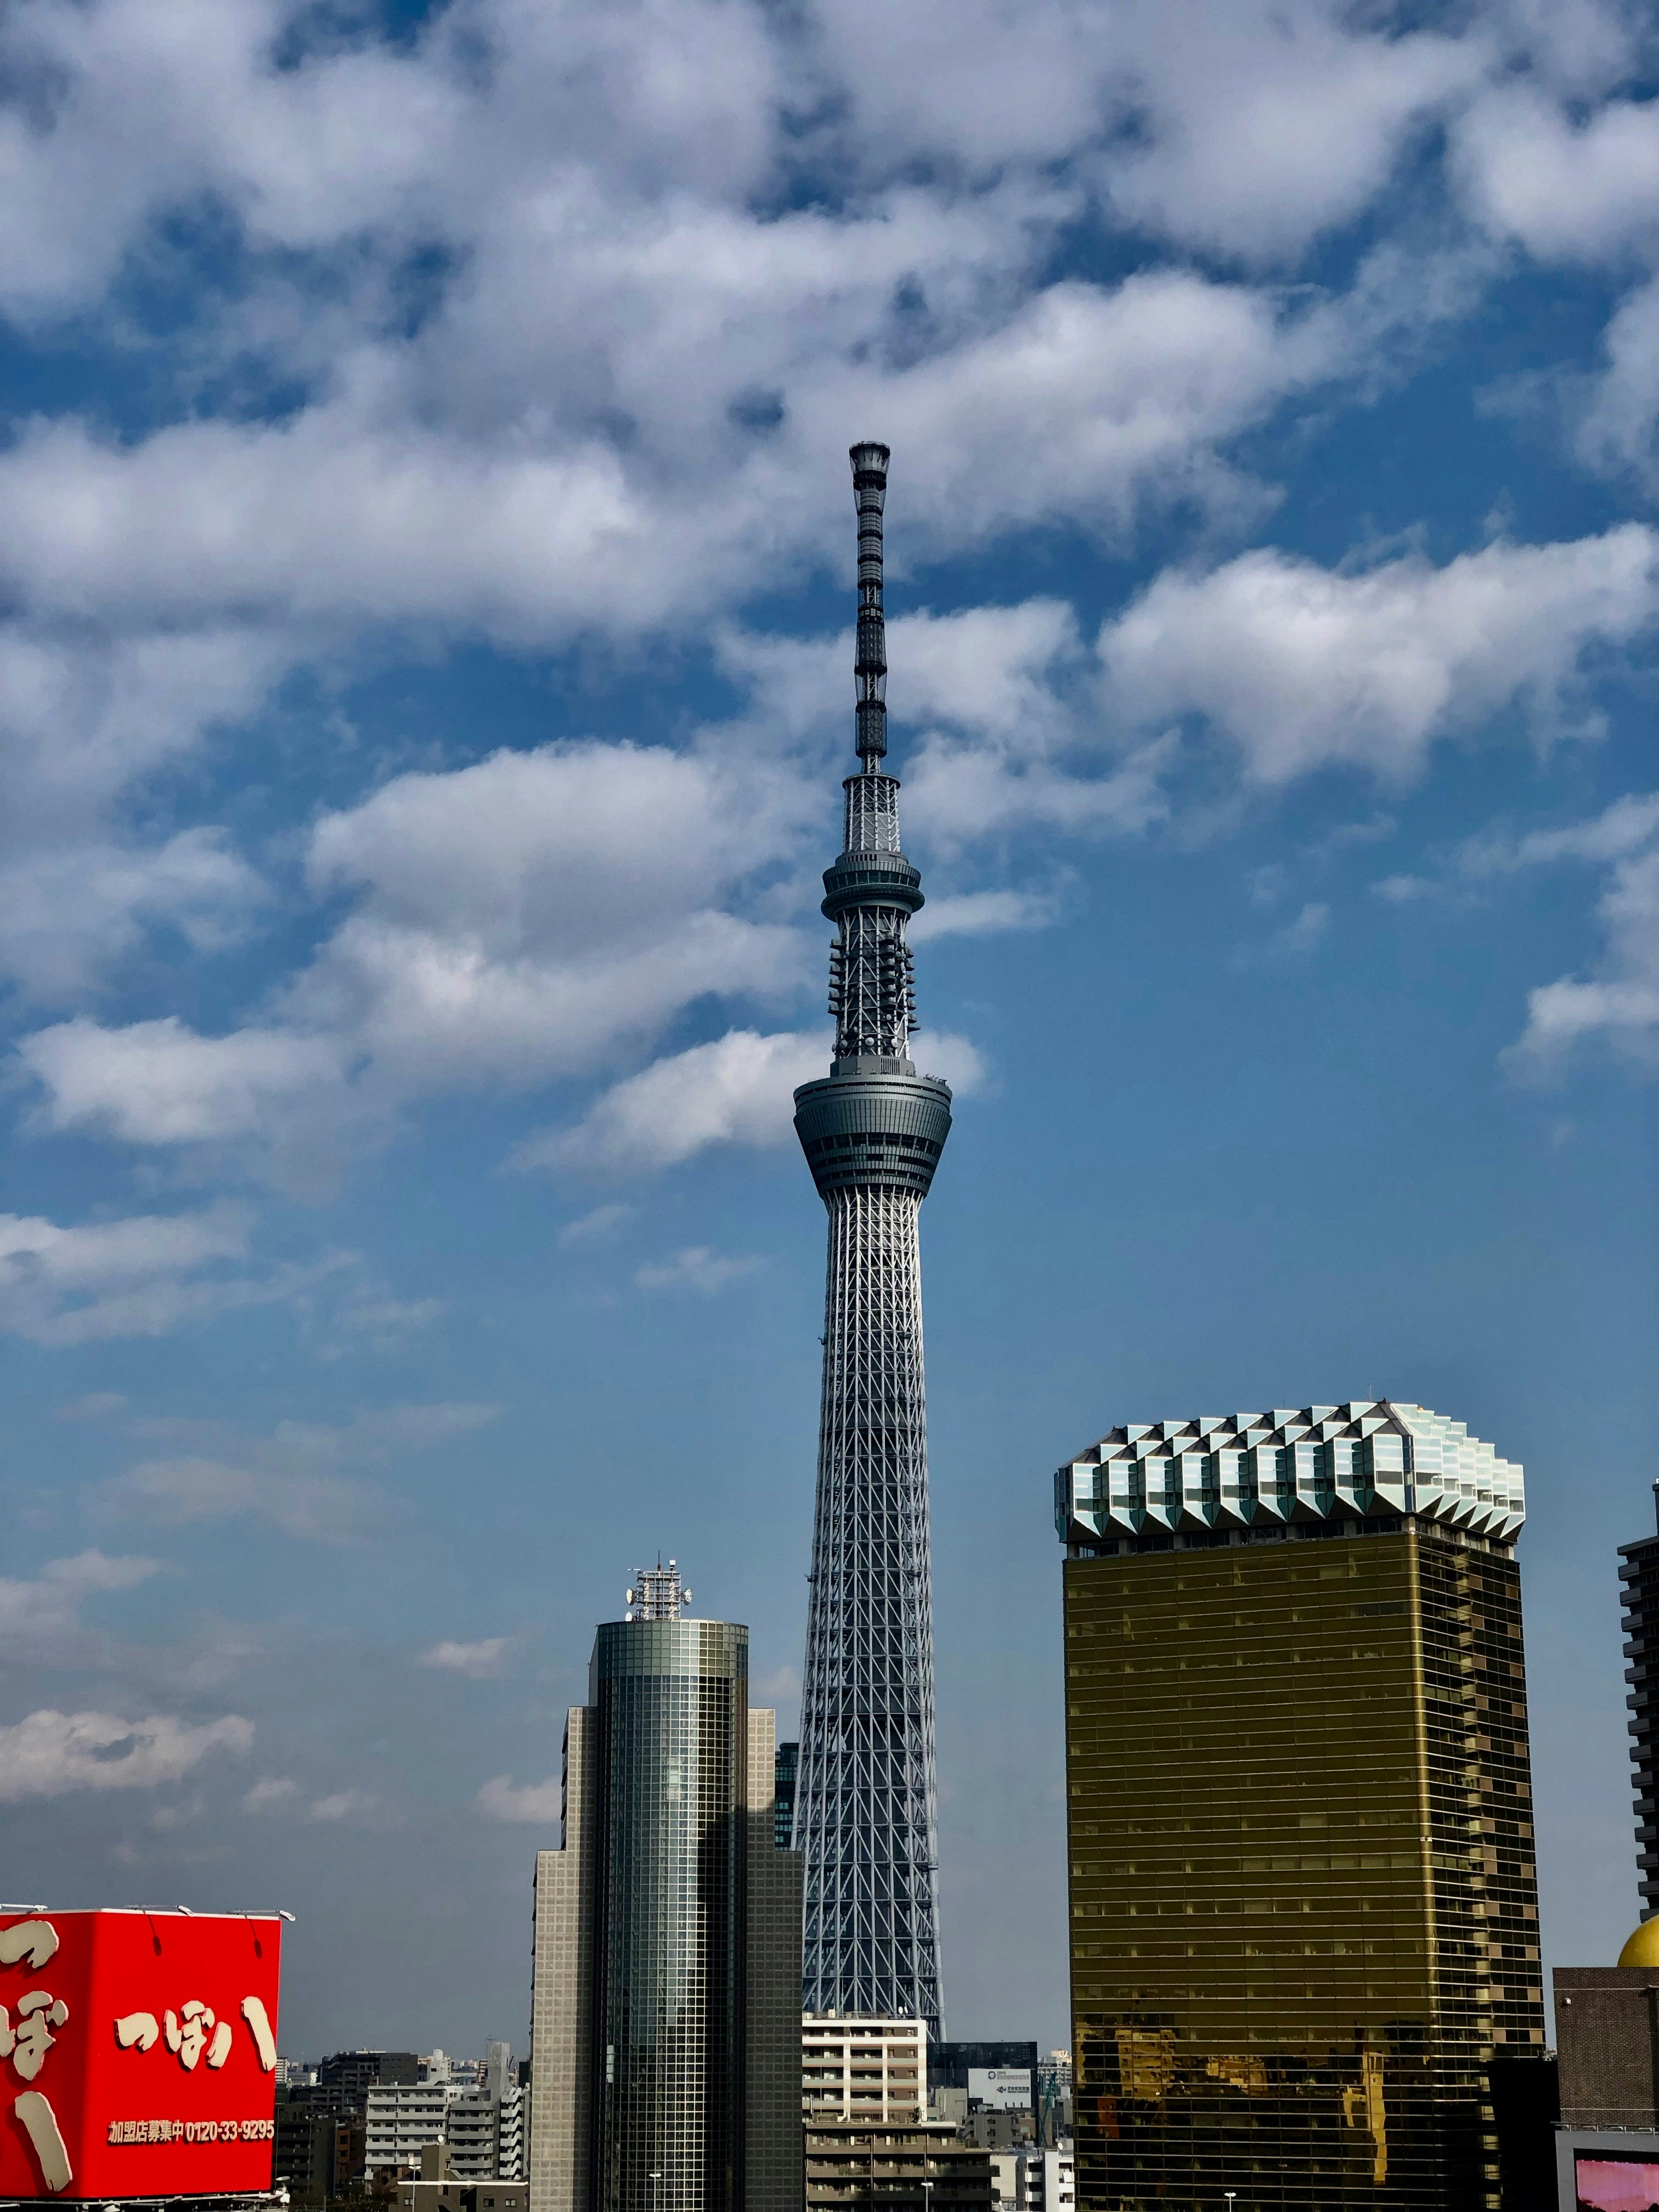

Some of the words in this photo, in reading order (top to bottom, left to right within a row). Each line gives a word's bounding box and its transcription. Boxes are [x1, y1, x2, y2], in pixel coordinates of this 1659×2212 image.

[115, 1996, 277, 2072] つぼ八
[108, 2120, 184, 2143] 加盟店募集中
[185, 2119, 274, 2142] 0120-33-9295
